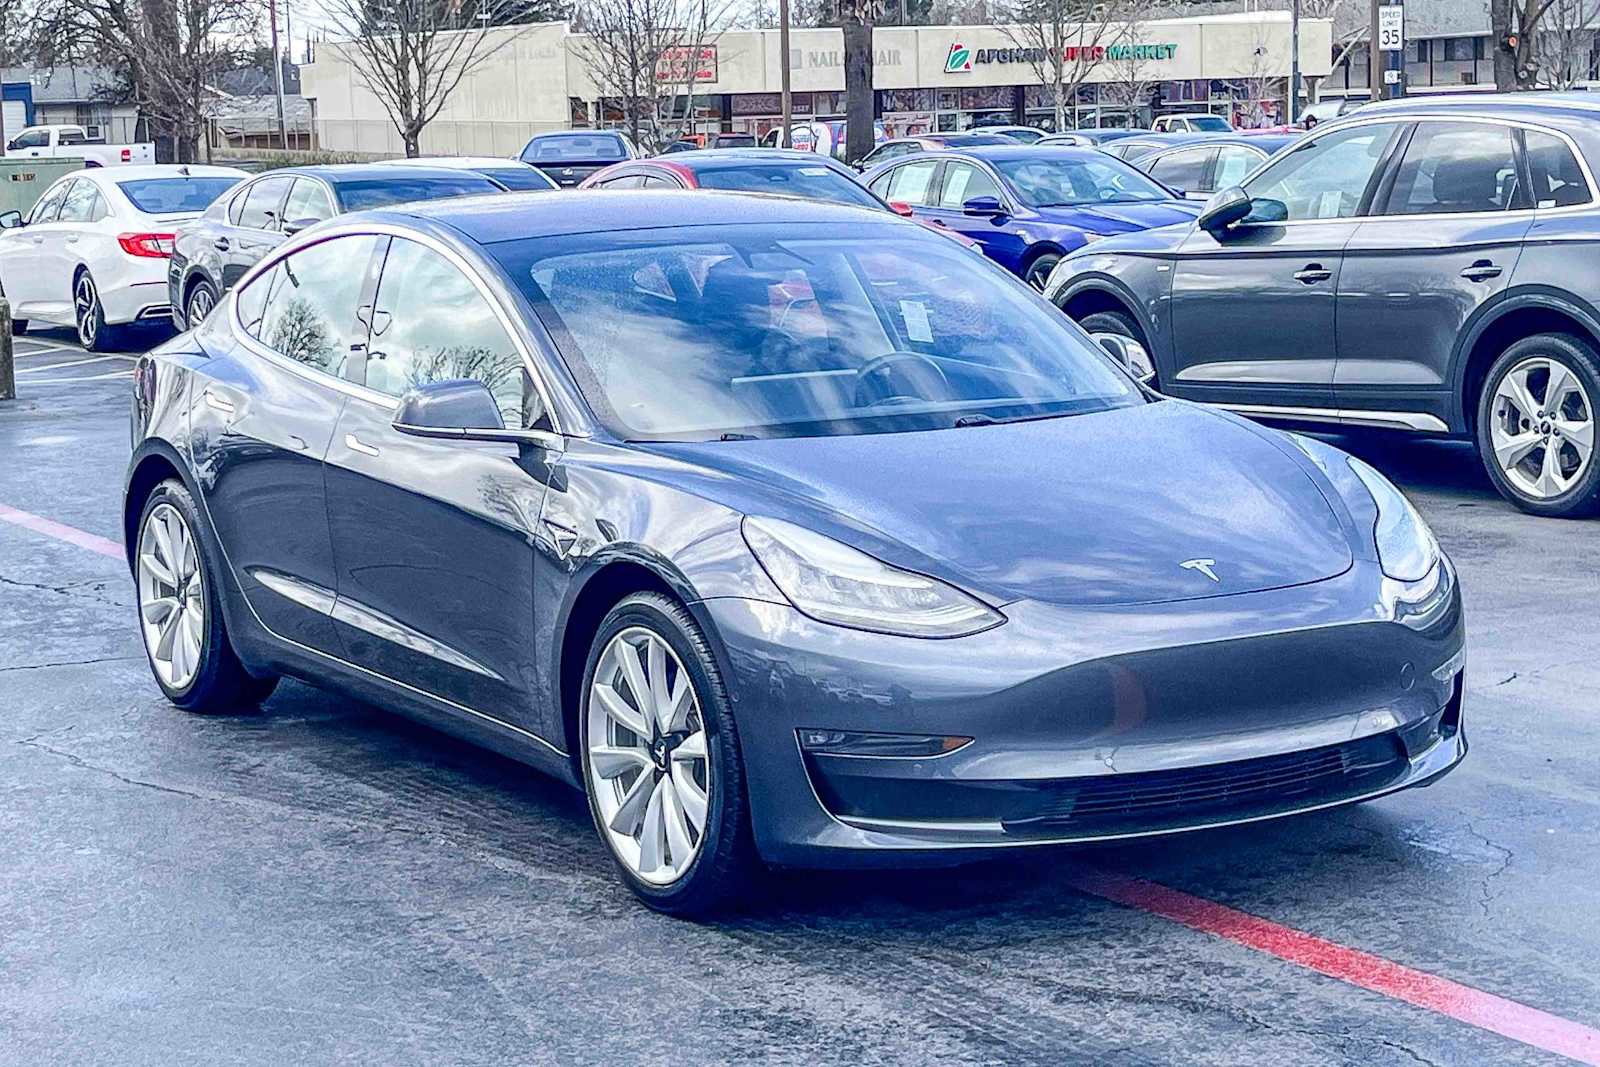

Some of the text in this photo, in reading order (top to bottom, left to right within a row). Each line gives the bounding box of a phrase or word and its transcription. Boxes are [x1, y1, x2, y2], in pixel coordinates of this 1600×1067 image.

[1382, 30, 1399, 45] 35
[808, 50, 845, 67] NAIL
[975, 47, 1046, 64] AFGHAN
[1106, 44, 1178, 61] MARKET
